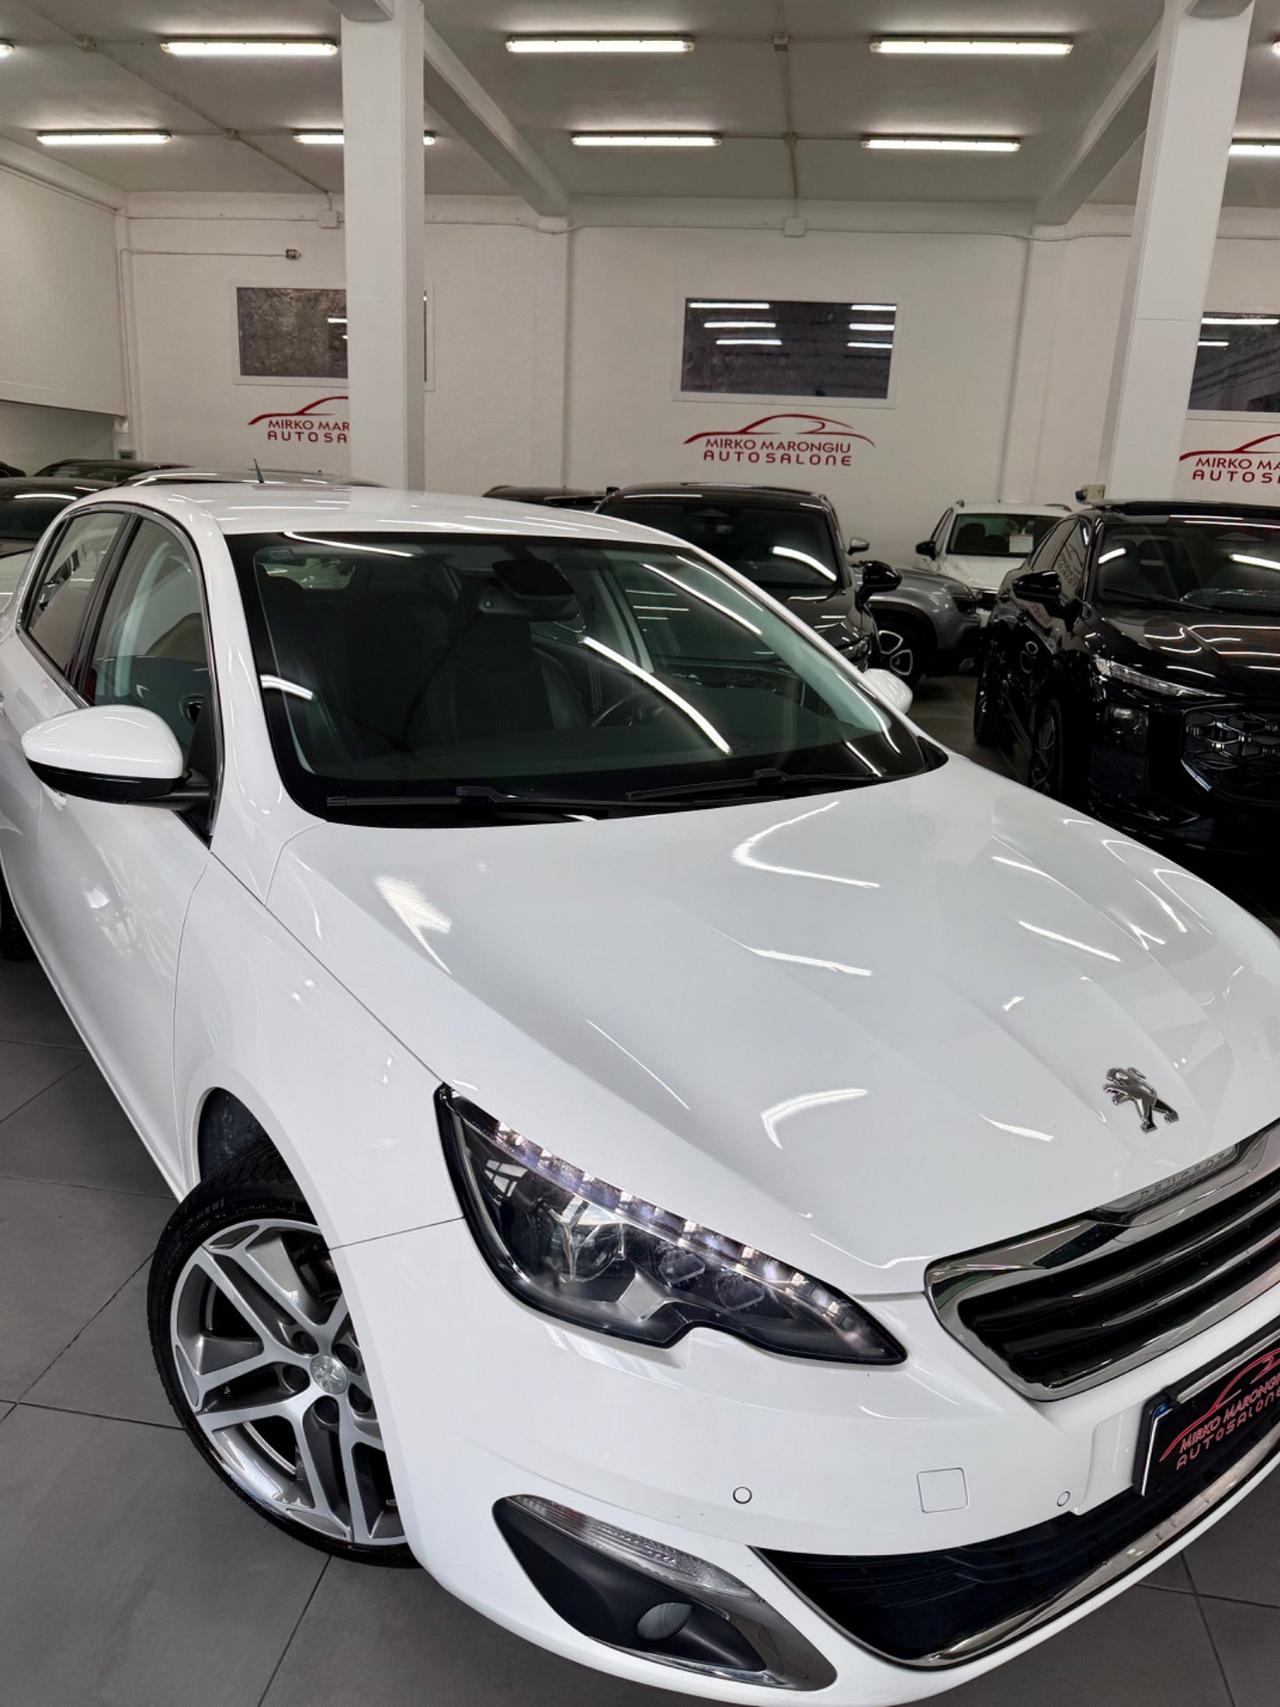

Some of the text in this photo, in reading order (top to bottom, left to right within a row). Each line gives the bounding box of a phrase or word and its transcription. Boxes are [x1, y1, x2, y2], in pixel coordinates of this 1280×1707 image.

[268, 419, 314, 430] MIRKO
[705, 438, 851, 454] MIRKO MARONGIU
[703, 450, 852, 466] AUTOSALONE
[1195, 457, 1253, 469] MIRKO
[1192, 469, 1280, 484] AUTOS
[1179, 1415, 1222, 1454] MIRKO
